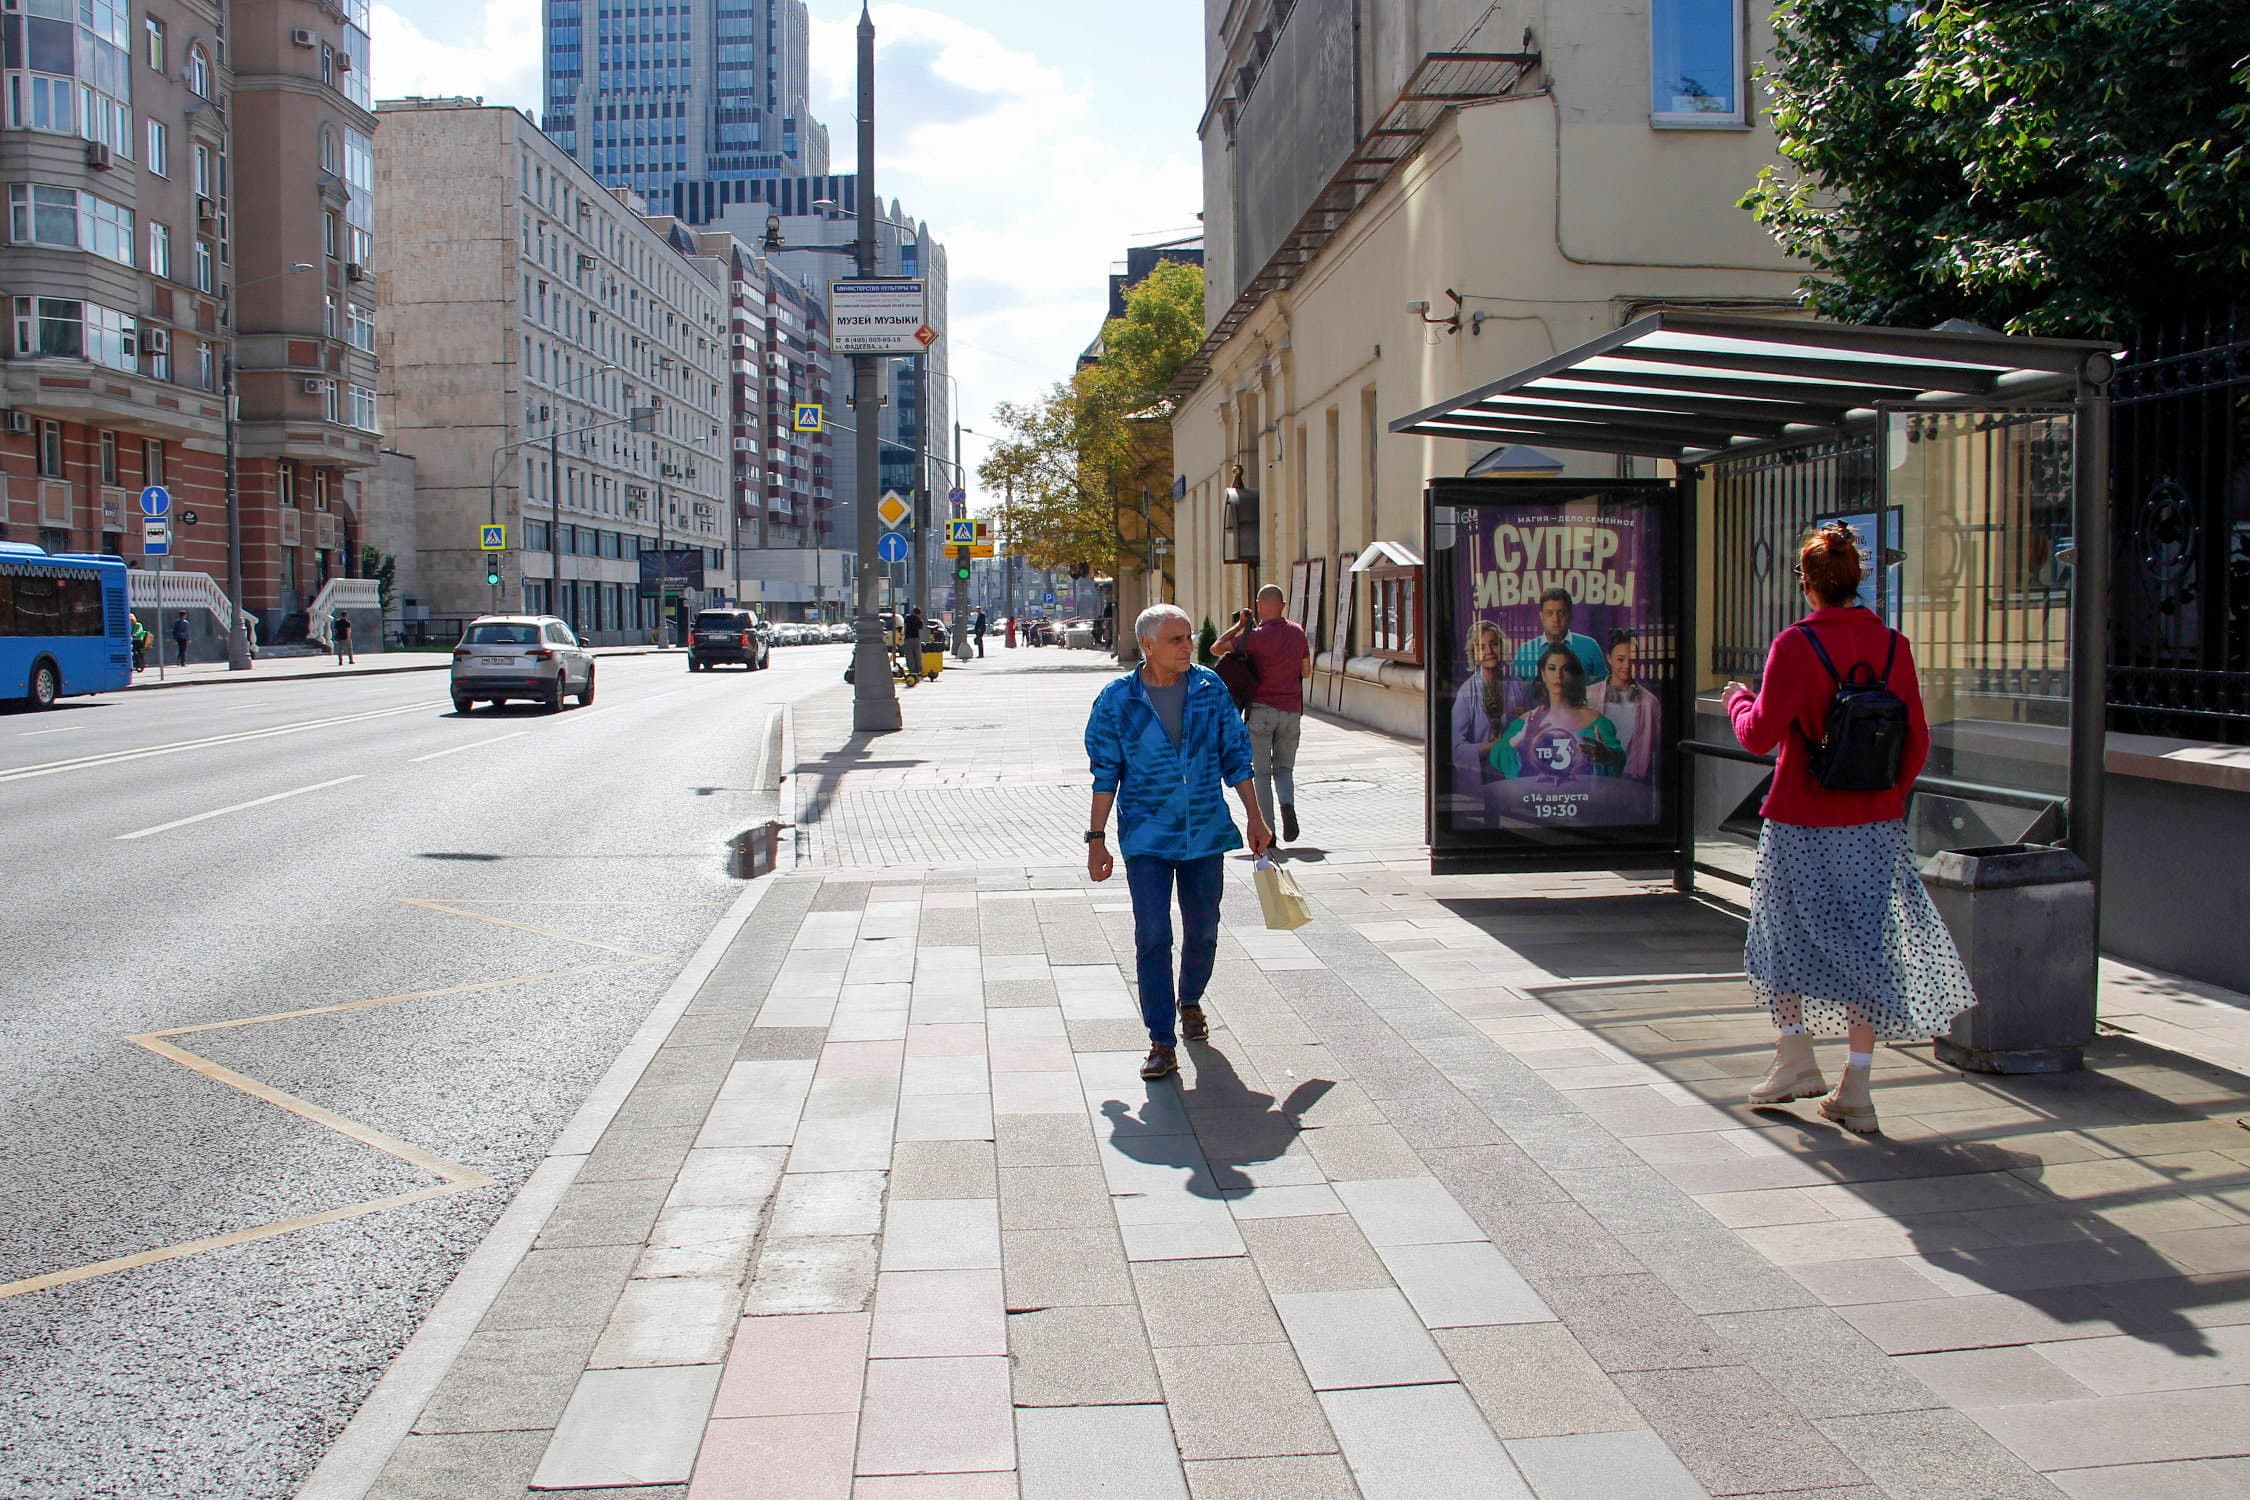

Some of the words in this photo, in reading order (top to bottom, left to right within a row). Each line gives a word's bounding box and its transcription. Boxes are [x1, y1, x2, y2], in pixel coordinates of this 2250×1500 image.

[837, 315, 871, 326] МУЗЕЙ
[874, 316, 918, 325] МУЗЫКИ
[1517, 515, 1549, 524] МАГИЯ
[1558, 515, 1583, 524] ДЕЛО
[1585, 514, 1636, 527] СЕМЕЙНОЕ
[1493, 524, 1619, 572] СУПЕР
[1475, 569, 1635, 609] ИВАНОВЫ
[1522, 795, 1529, 803] с
[1530, 793, 1543, 802] 14
[1545, 794, 1589, 804] августа
[1535, 804, 1578, 818] 19:30
